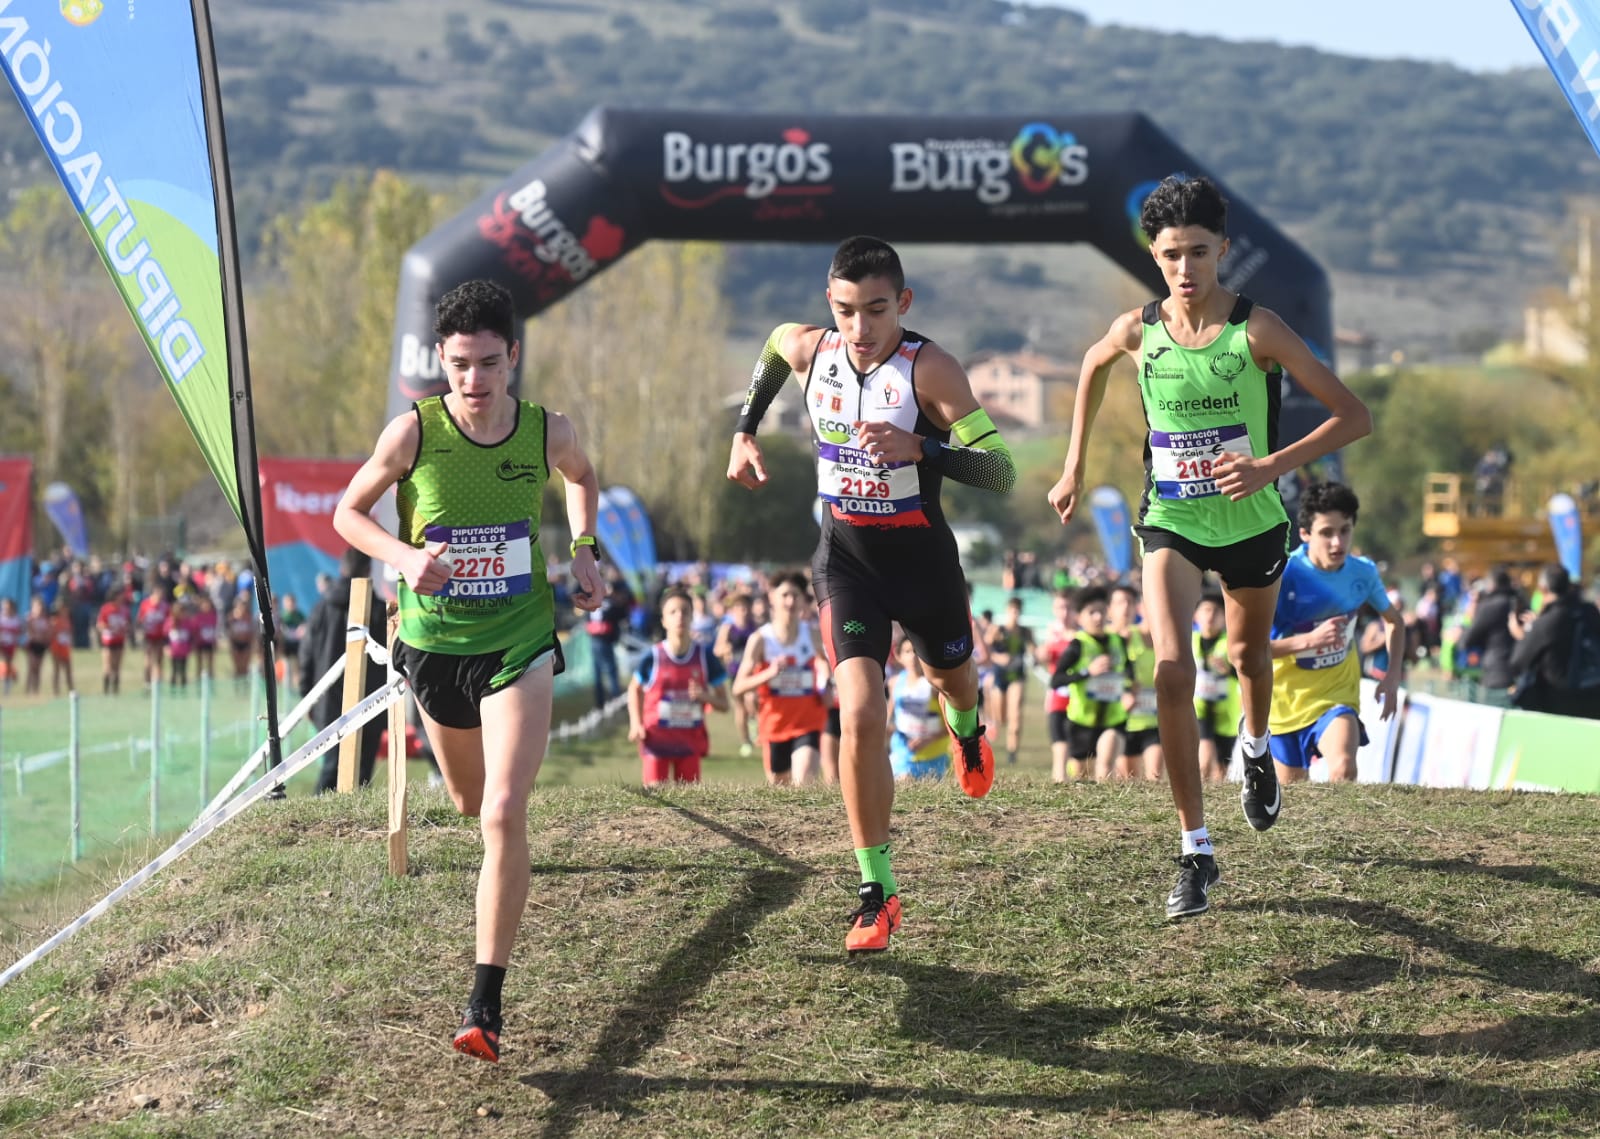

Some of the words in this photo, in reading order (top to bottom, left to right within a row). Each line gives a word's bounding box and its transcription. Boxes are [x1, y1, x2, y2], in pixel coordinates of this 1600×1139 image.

[662, 132, 832, 198] Burgos
[508, 179, 598, 281] Burgos
[819, 374, 844, 390] VIATOR
[1169, 429, 1219, 441] DIPUTACIÓN
[1170, 437, 1221, 448] BURGOS
[1176, 459, 1222, 480] 218
[840, 477, 890, 499] 2129
[451, 525, 507, 536] DIPUTACIÓN
[451, 534, 507, 544] BURGOS
[452, 556, 505, 578] 2276
